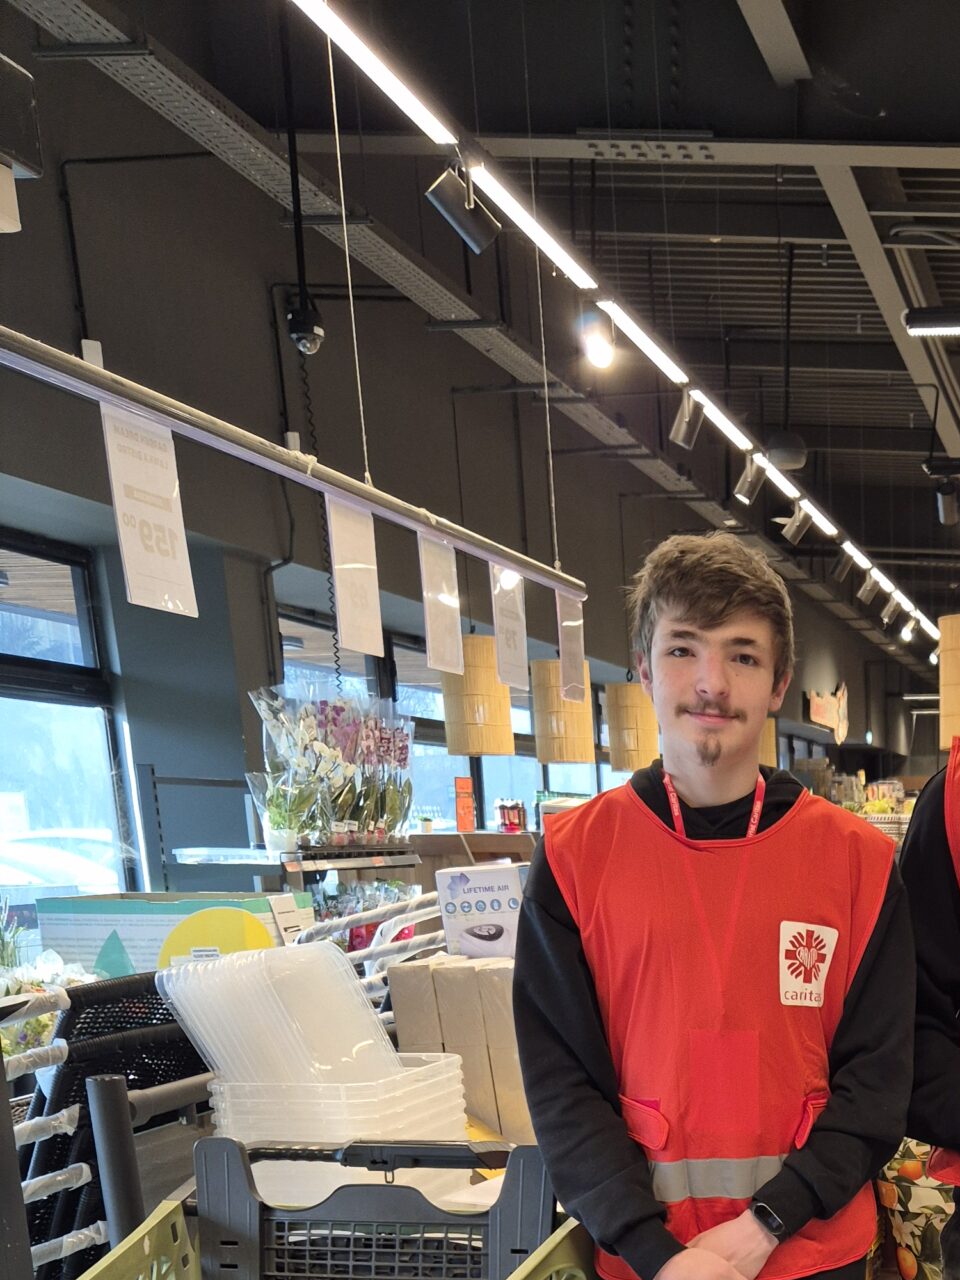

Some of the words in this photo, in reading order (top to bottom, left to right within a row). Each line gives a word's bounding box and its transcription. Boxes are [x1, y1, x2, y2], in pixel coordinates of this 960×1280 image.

[463, 886, 496, 894] LIFETIME
[497, 884, 509, 892] AIR
[783, 988, 823, 1002] carita
